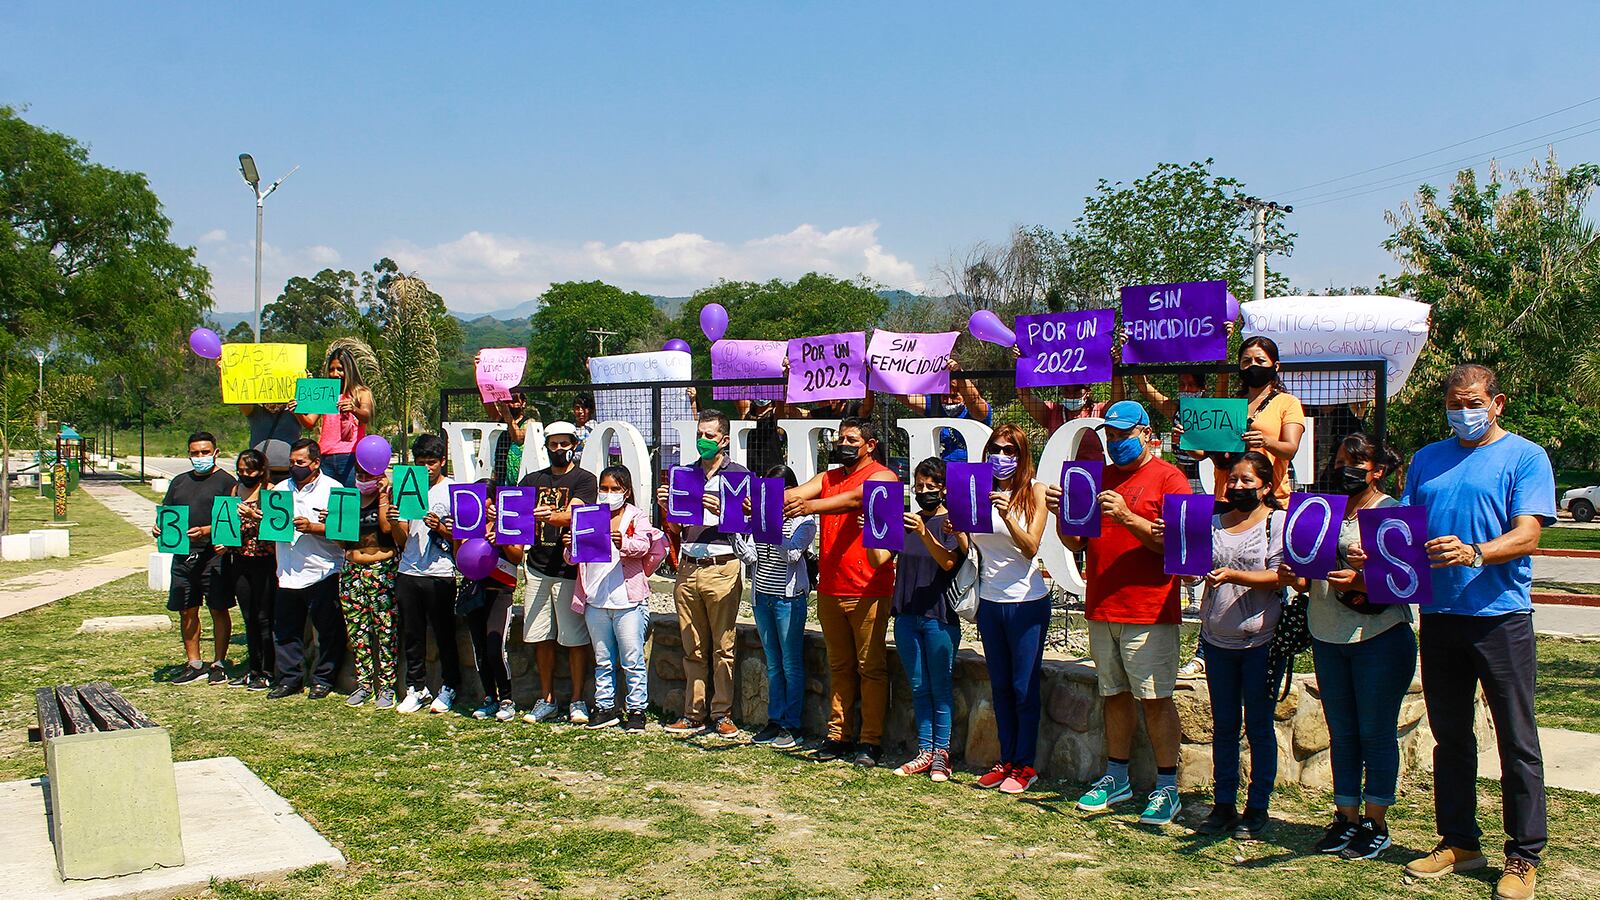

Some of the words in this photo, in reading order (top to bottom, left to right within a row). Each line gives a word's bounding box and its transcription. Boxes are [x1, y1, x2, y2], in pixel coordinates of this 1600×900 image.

[1148, 288, 1182, 311] SIN
[1028, 321, 1066, 345] POR
[1076, 317, 1097, 340] UN
[802, 342, 825, 363] POR
[834, 341, 850, 360] UN
[889, 337, 917, 353] SIN
[1293, 341, 1325, 357] NOS
[1328, 338, 1417, 357] GARANTICEN
[222, 345, 289, 368] BASTA
[643, 357, 659, 369] de
[1033, 347, 1088, 374] 2022
[252, 363, 273, 378] DE
[717, 361, 768, 374] FEMICIDIOS
[803, 363, 851, 392] 2022
[298, 386, 336, 401] BASTA
